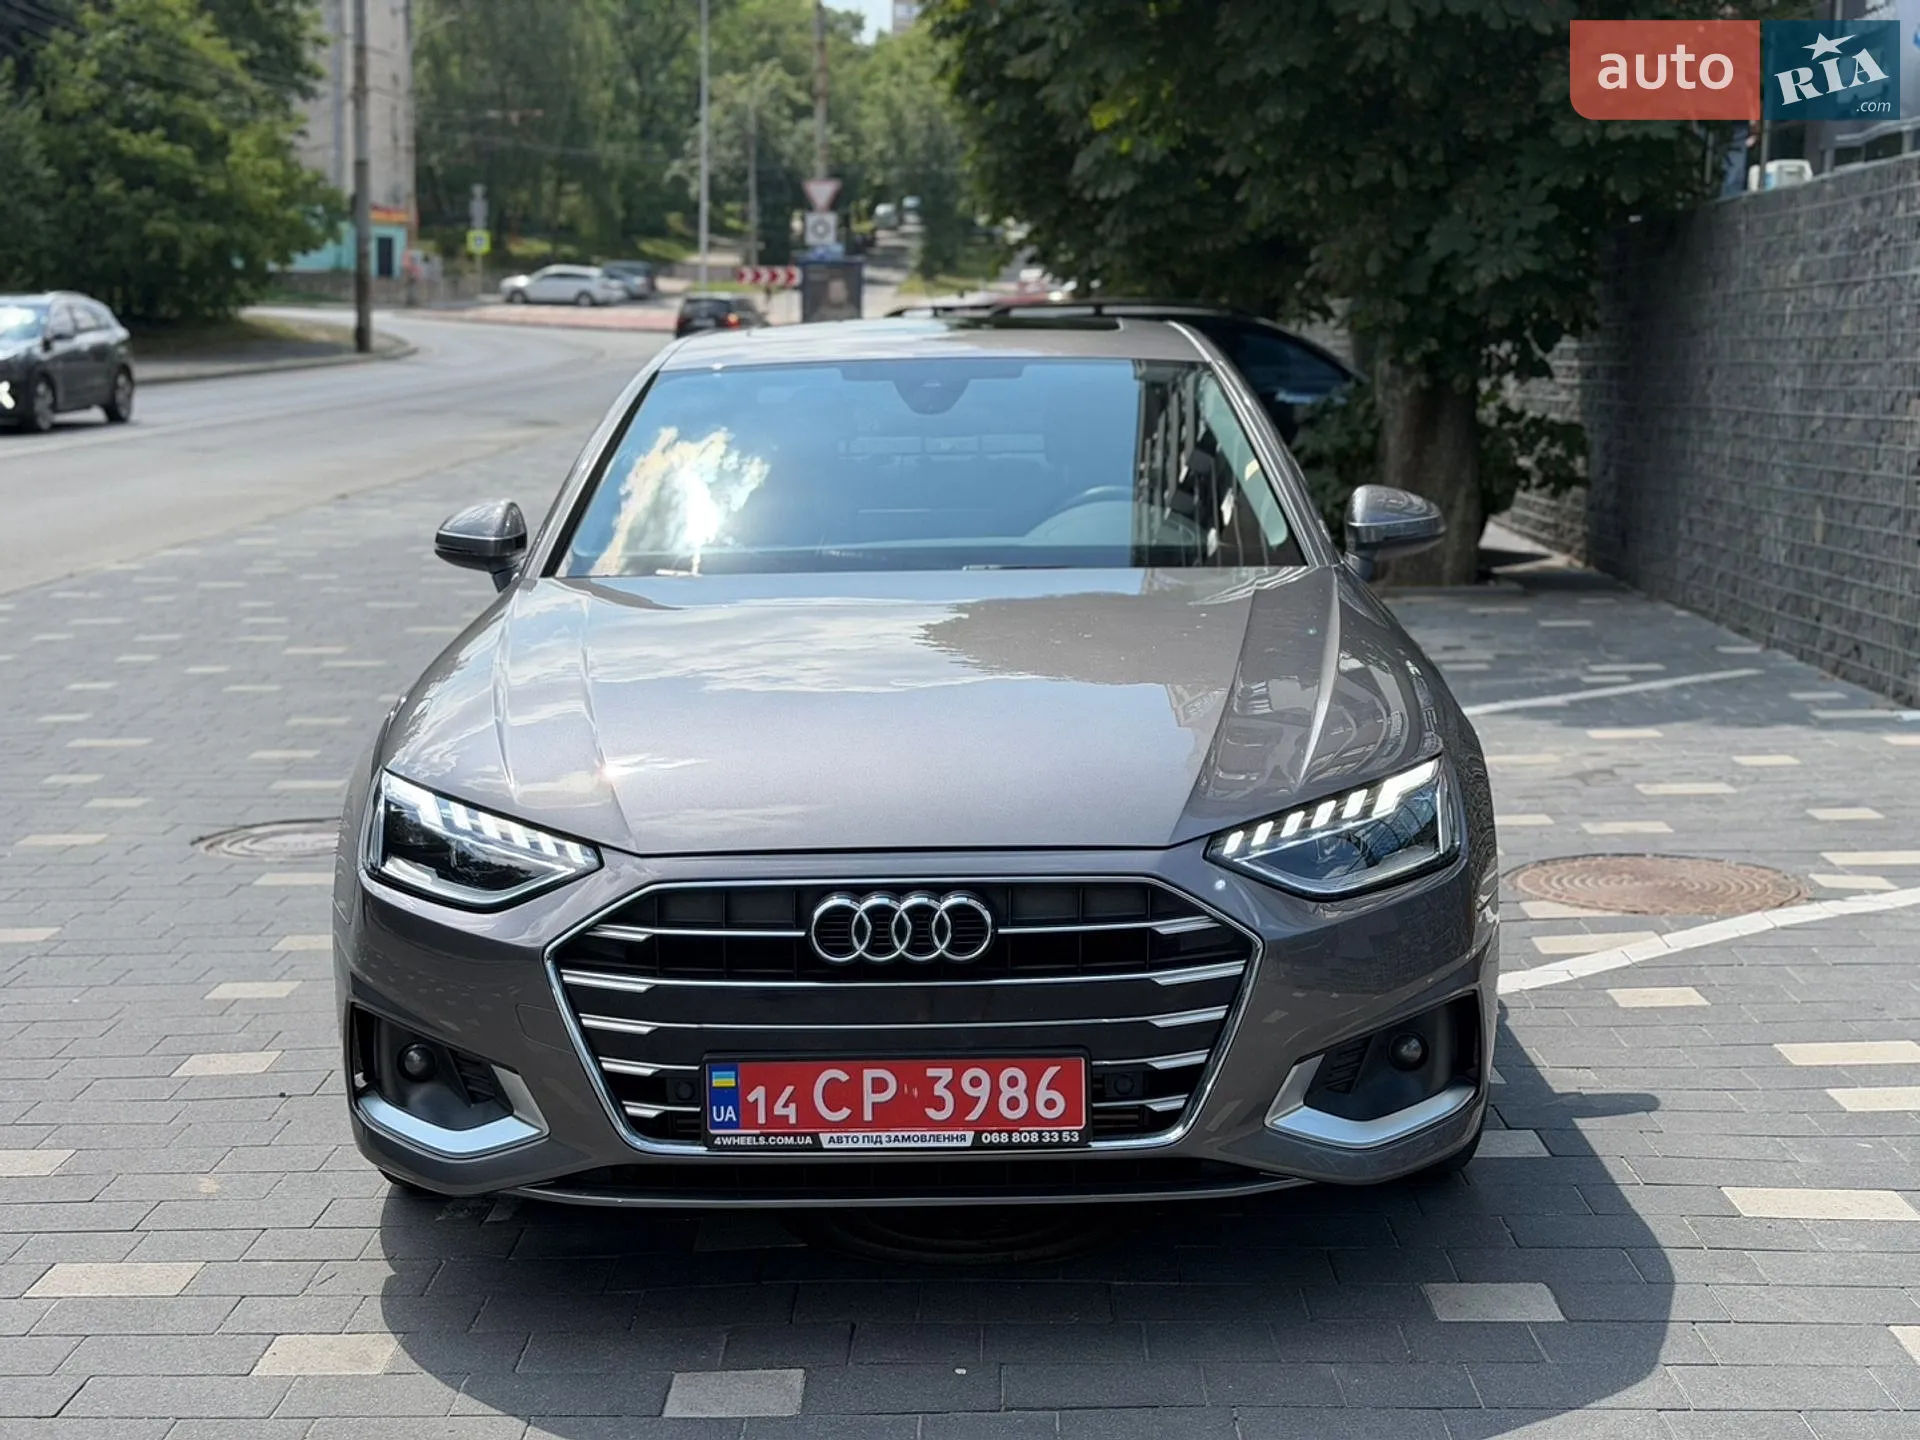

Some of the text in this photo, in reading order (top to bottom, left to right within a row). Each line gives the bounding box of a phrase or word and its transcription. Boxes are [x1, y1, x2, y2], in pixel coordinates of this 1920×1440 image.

[746, 1065, 1066, 1125] 14 CP 3986
[712, 1105, 736, 1122] UA
[714, 1136, 813, 1146] 4WHEELS.COM.UA
[827, 1133, 967, 1146] АВТО ПІД ЗАМОВЛЕННЯ
[981, 1131, 1080, 1144] 068 808 33 53
